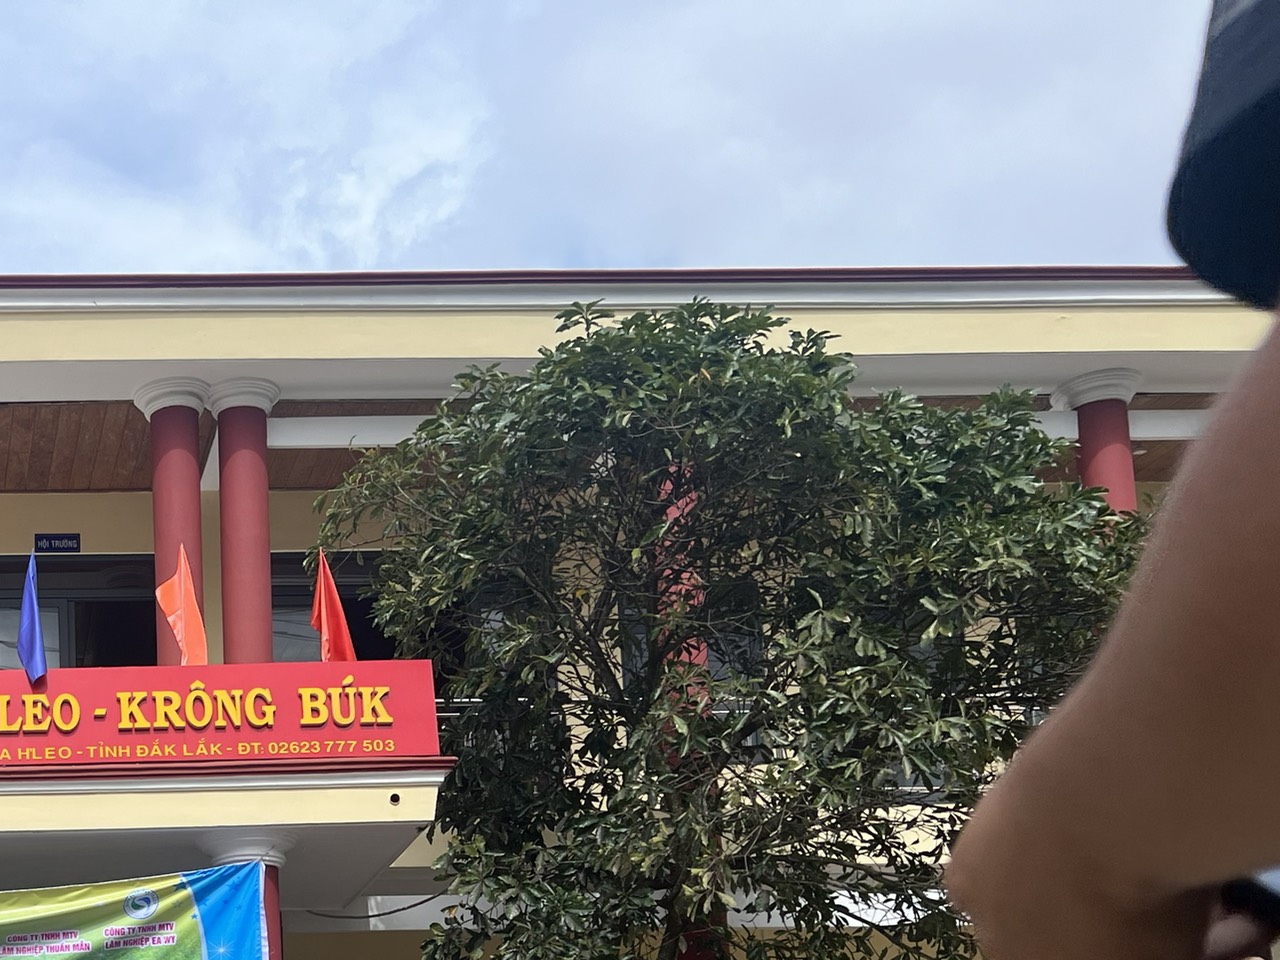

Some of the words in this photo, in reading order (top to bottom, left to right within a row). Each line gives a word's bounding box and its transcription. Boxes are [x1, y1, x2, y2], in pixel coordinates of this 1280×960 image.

[116, 680, 276, 732] KRÔNG
[298, 675, 394, 726] BÚK
[86, 741, 131, 758] TỈNH
[136, 738, 177, 757] ĐẮK
[183, 738, 222, 756] LẮK
[237, 742, 265, 755] ĐT:
[268, 741, 321, 754] 02623
[324, 740, 357, 753] 777
[362, 739, 395, 752] 503
[104, 926, 125, 936] CÔNG
[127, 926, 136, 935] TY
[138, 924, 156, 933] TNHH
[158, 922, 174, 932] MTV
[7, 934, 28, 943] CÔNG
[40, 932, 60, 941] TNHH
[62, 931, 78, 940] MTV
[105, 938, 121, 949] LÂM
[123, 935, 150, 948] NGHIỆP
[151, 936, 162, 945] EA
[16, 944, 44, 956] NGHIỆP
